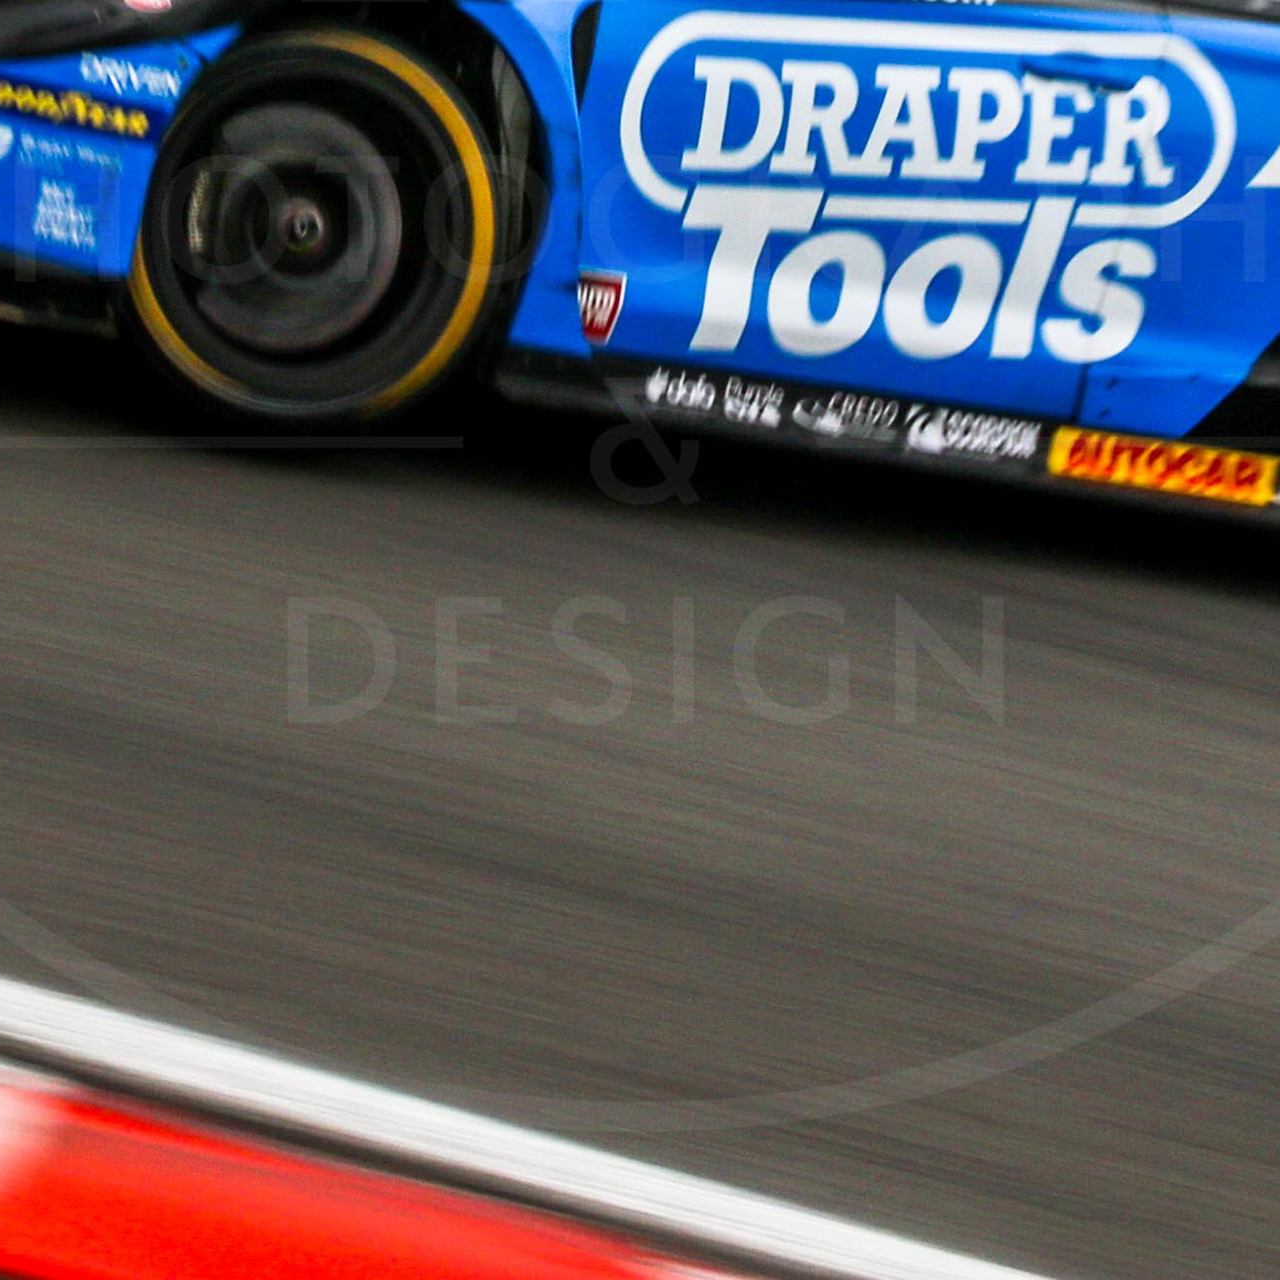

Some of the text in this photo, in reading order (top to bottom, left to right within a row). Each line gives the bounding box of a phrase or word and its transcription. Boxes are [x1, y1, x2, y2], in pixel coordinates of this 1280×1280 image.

[681, 55, 1175, 187] DRAPER
[682, 184, 1158, 363] Tools
[1065, 429, 1267, 493] AUTOCAR
